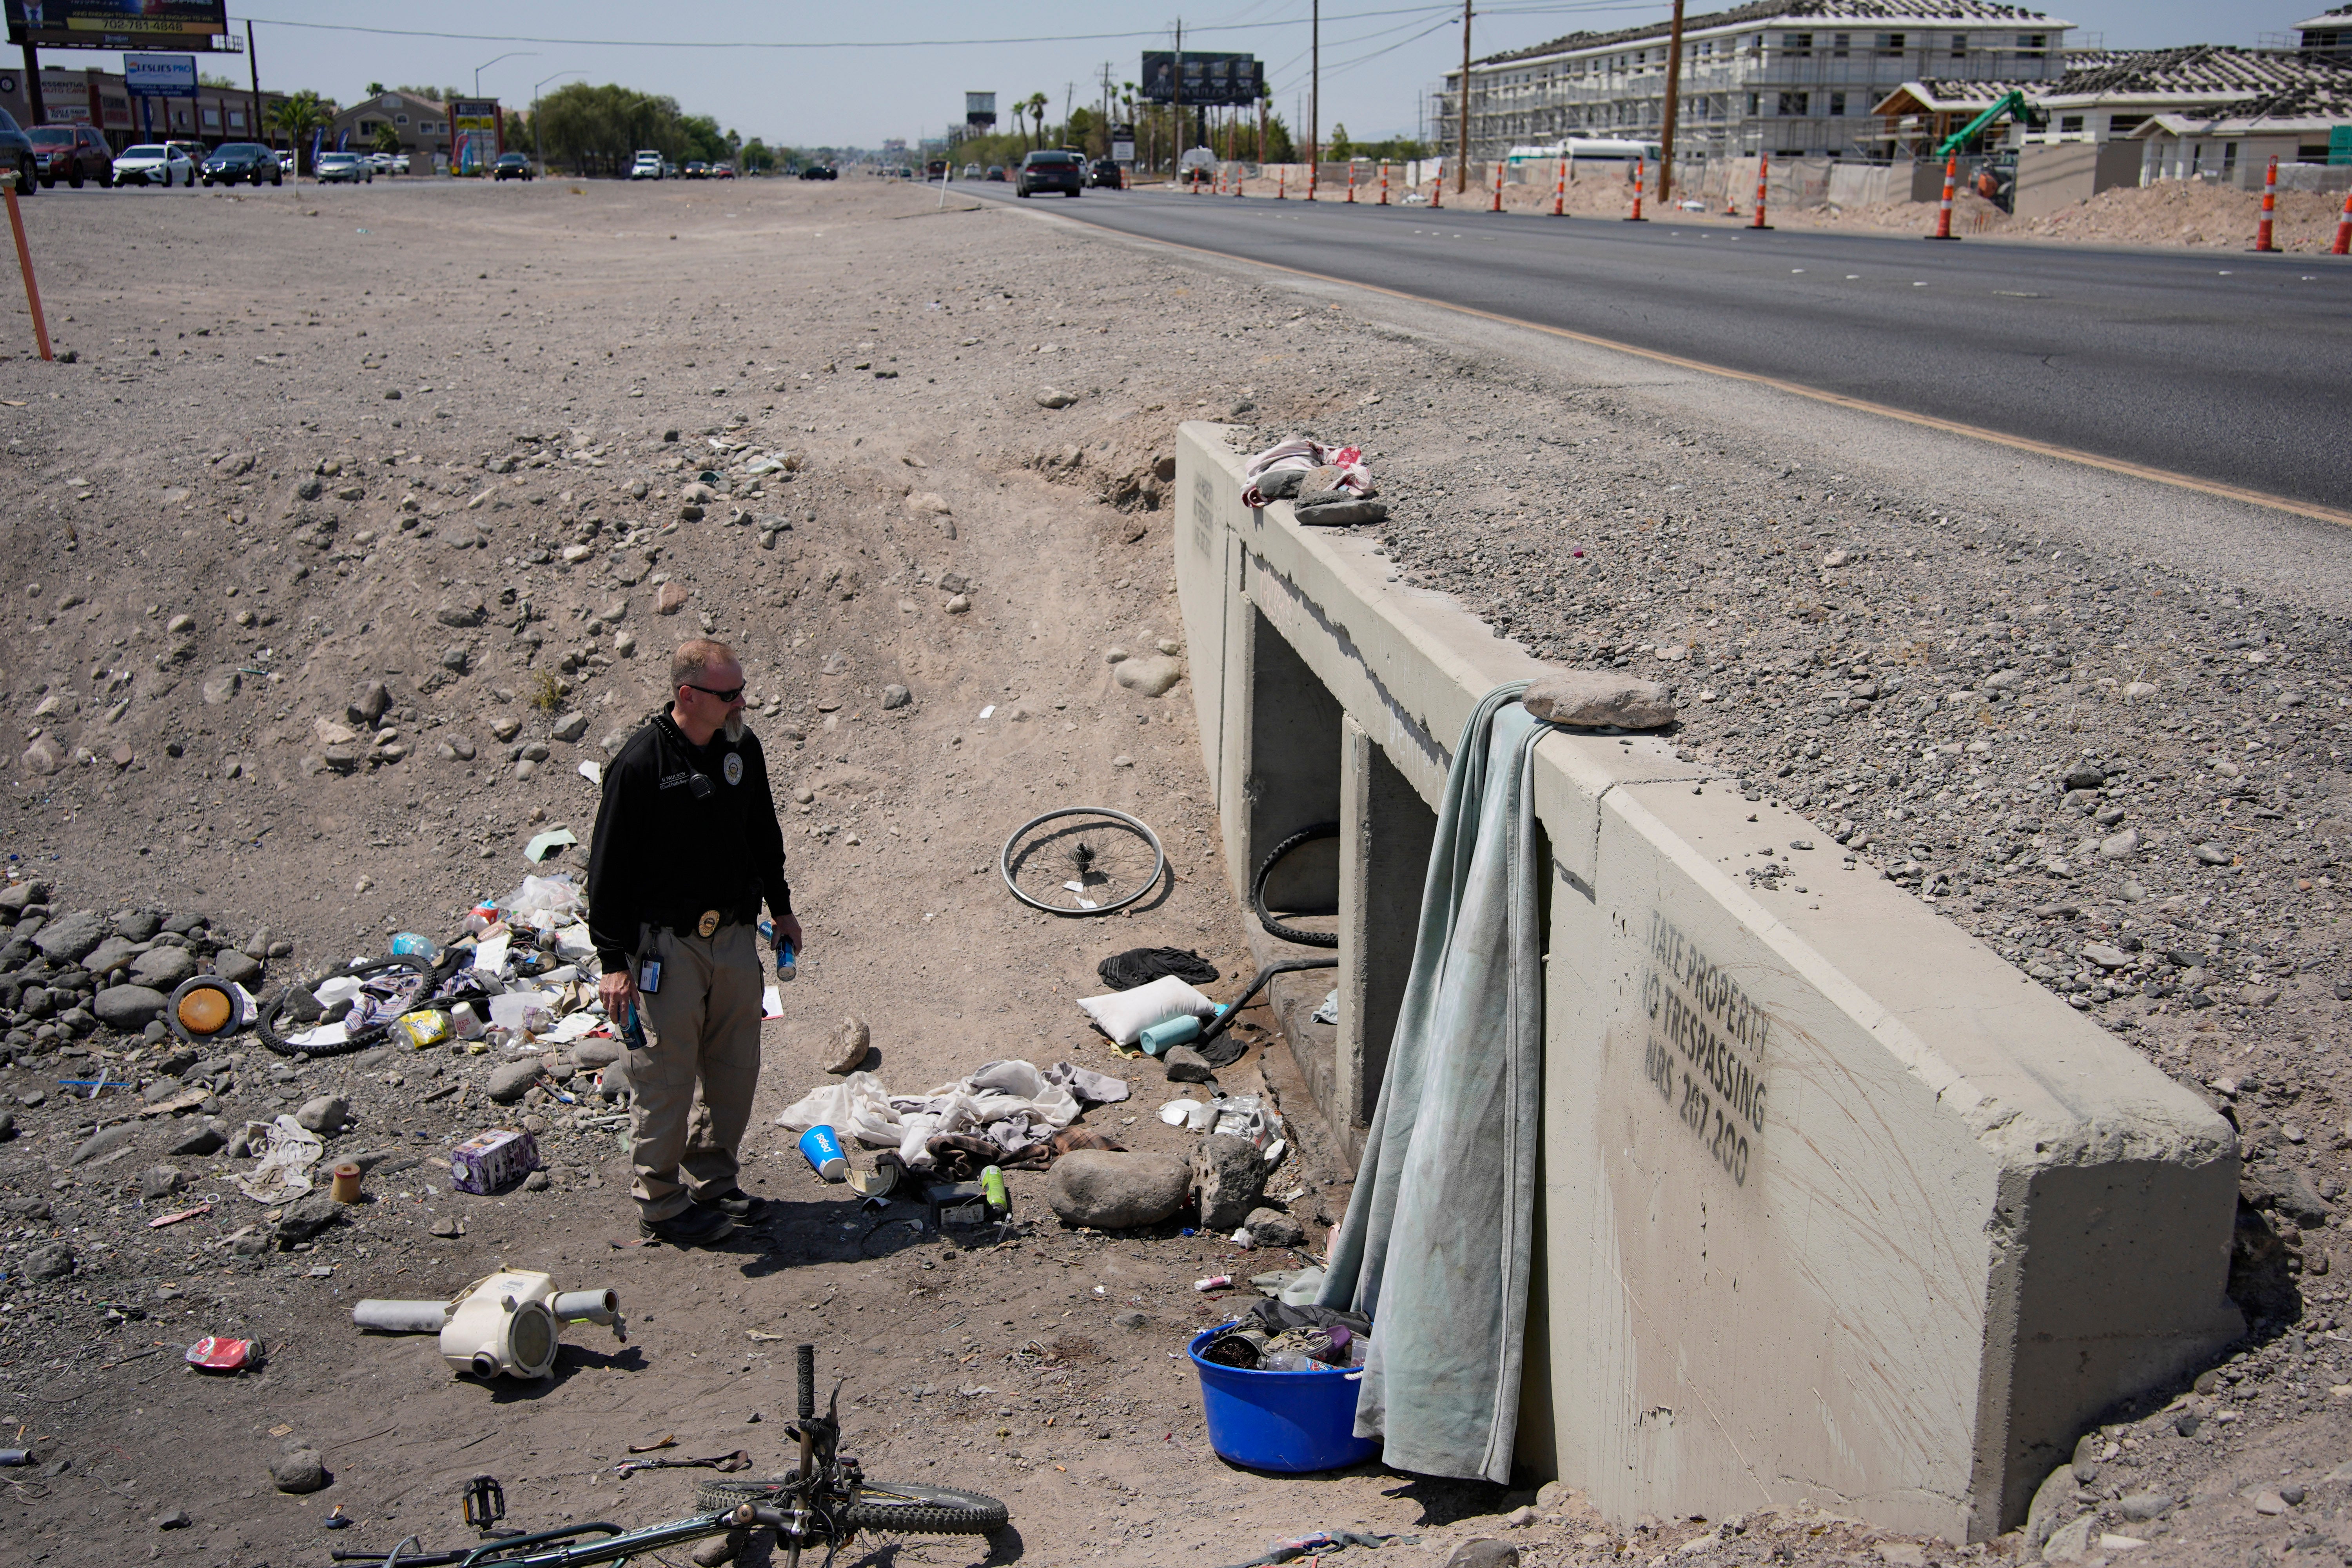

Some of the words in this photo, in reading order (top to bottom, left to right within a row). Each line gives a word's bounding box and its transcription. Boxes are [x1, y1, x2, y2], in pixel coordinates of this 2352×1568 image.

[102, 19, 183, 31] 702-781-4848
[173, 65, 191, 73] PRO
[1646, 909, 1684, 979] TATE
[1686, 944, 1769, 1061] PROPERTY
[1664, 984, 1766, 1133] TRESPASSING
[813, 1133, 834, 1152] pepsi
[1645, 1034, 1673, 1101] NRS
[1680, 1072, 1748, 1187] 207.200
